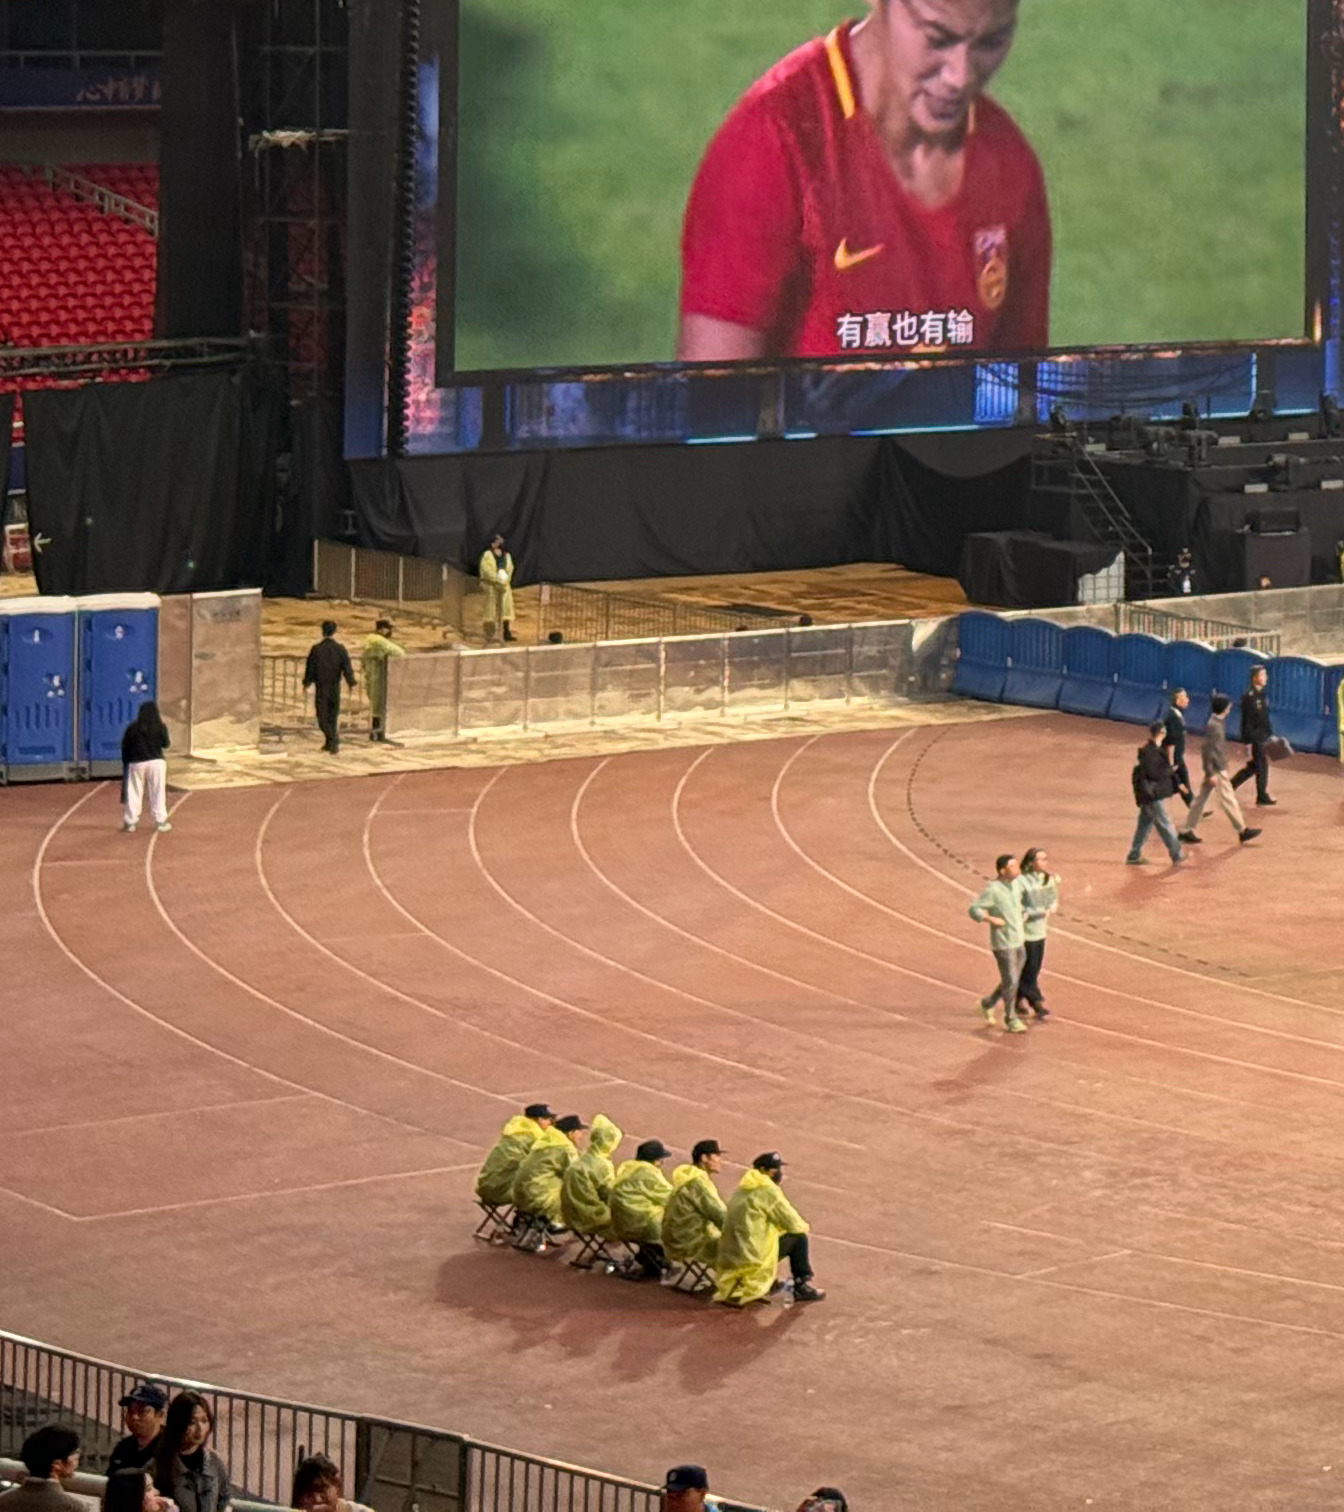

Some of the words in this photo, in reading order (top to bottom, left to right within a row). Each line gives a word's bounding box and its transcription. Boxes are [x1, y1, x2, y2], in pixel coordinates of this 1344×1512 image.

[837, 309, 974, 349] 有赢也有输
